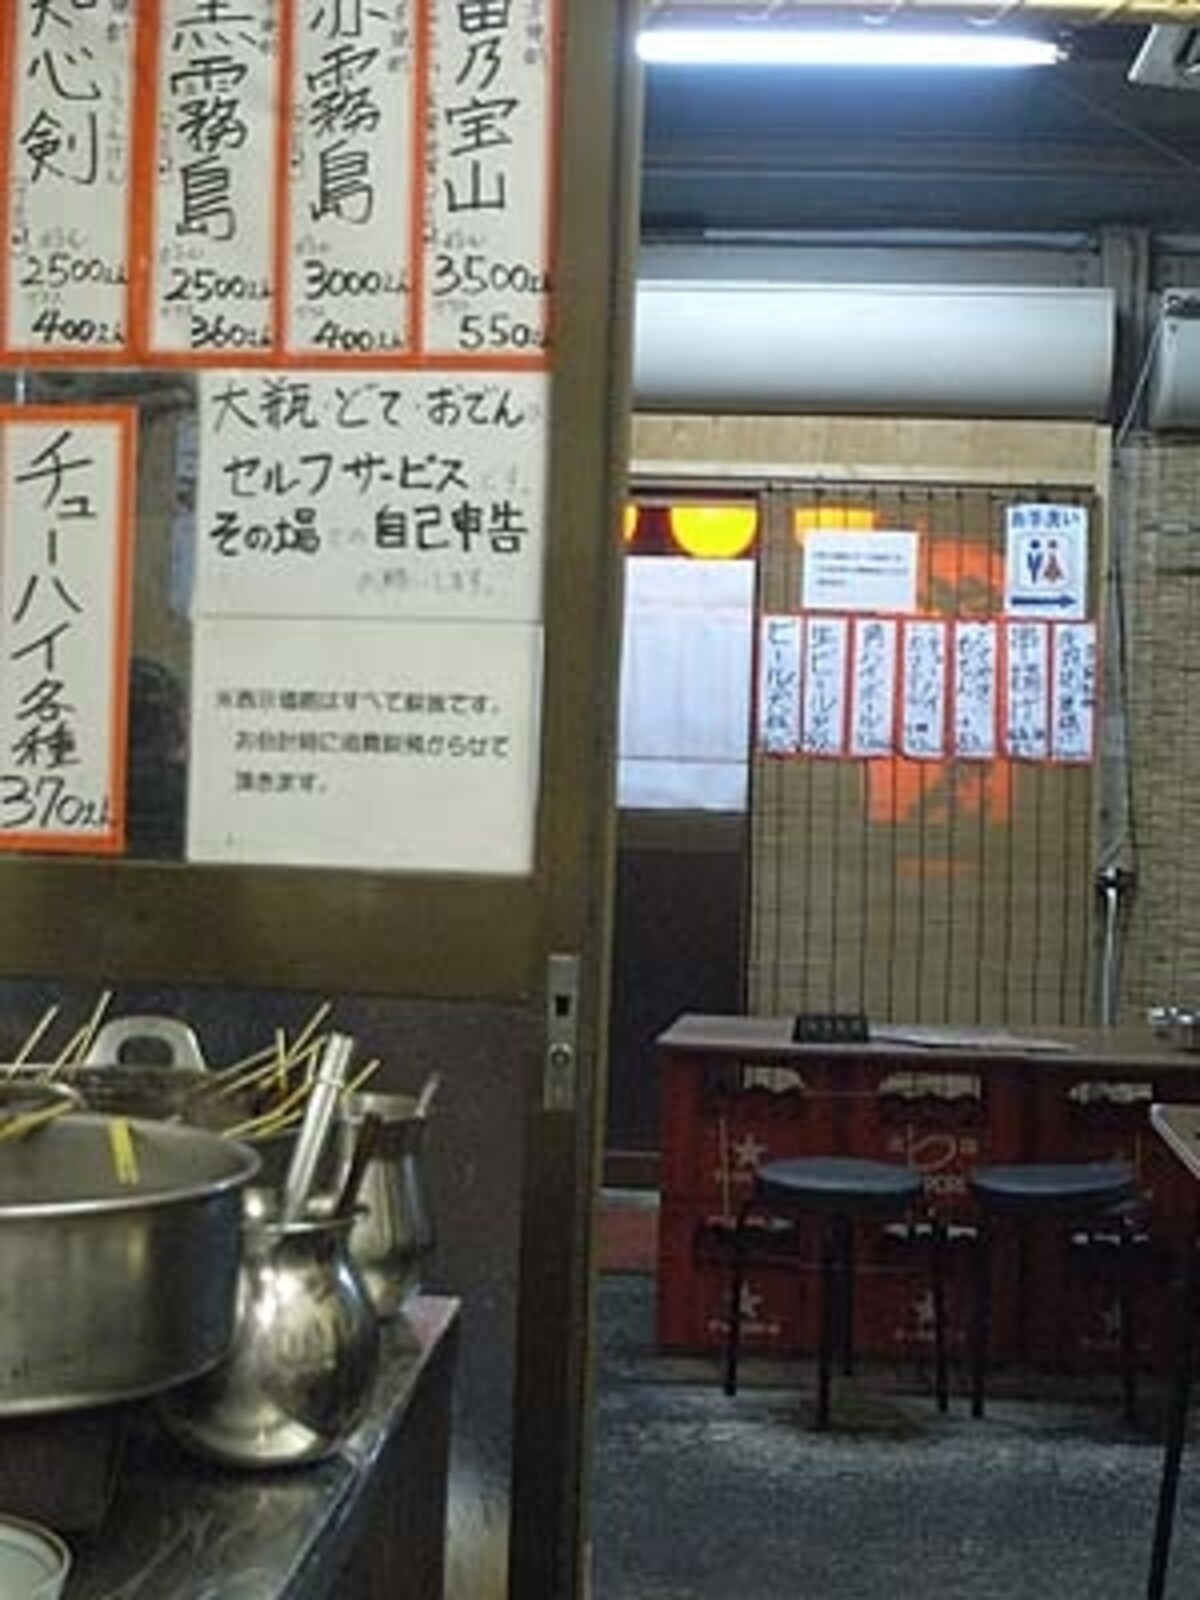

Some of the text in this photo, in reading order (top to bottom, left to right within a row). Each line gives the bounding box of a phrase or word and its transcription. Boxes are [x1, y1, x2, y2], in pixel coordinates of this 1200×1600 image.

[427, 384, 525, 428] おでん
[223, 452, 469, 498] セルフサービス
[209, 507, 320, 556] その場
[375, 500, 528, 553] 自己申告
[11, 430, 97, 768] チューハイ各種
